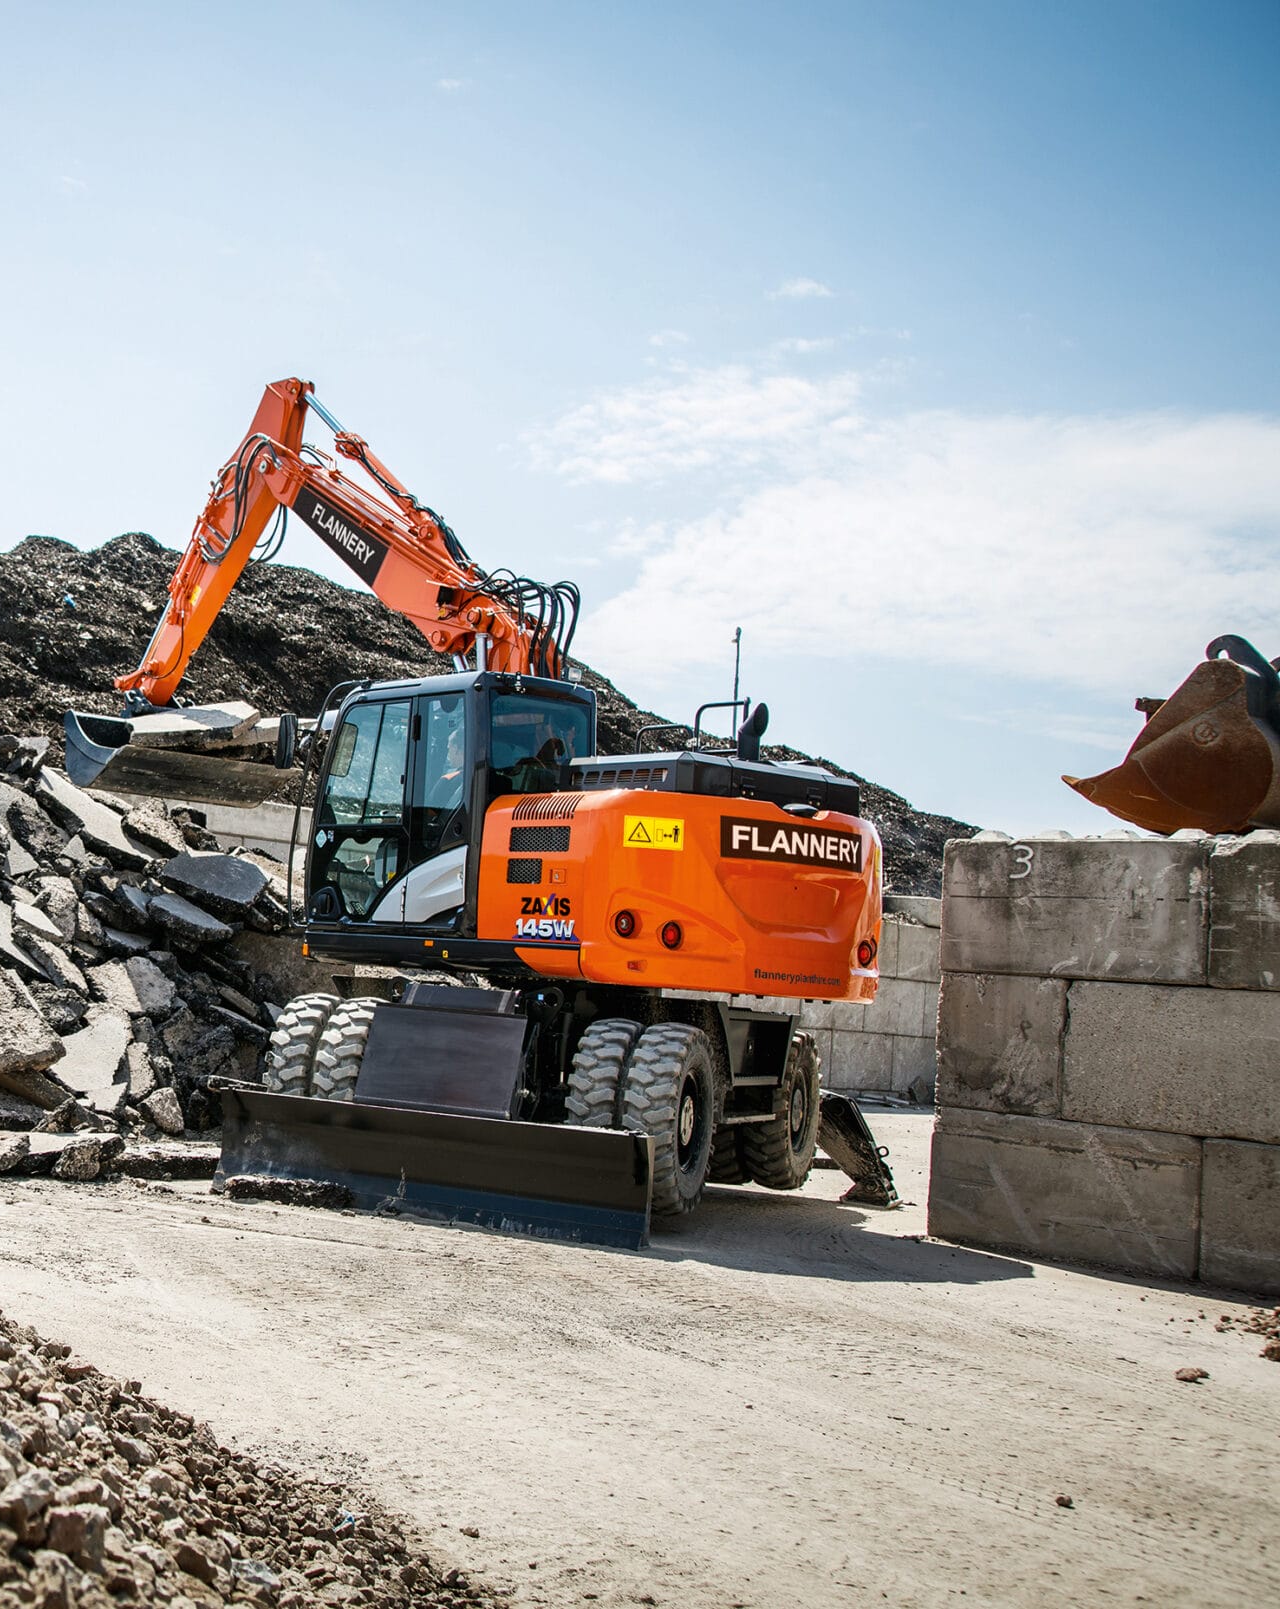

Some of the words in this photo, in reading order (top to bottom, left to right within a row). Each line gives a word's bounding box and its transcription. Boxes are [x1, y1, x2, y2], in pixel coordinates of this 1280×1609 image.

[311, 503, 375, 564] FLANNERY
[732, 825, 859, 864] FLANNERY
[1010, 845, 1034, 879] 3
[521, 893, 571, 916] ZAXIS
[516, 918, 575, 939] 145W
